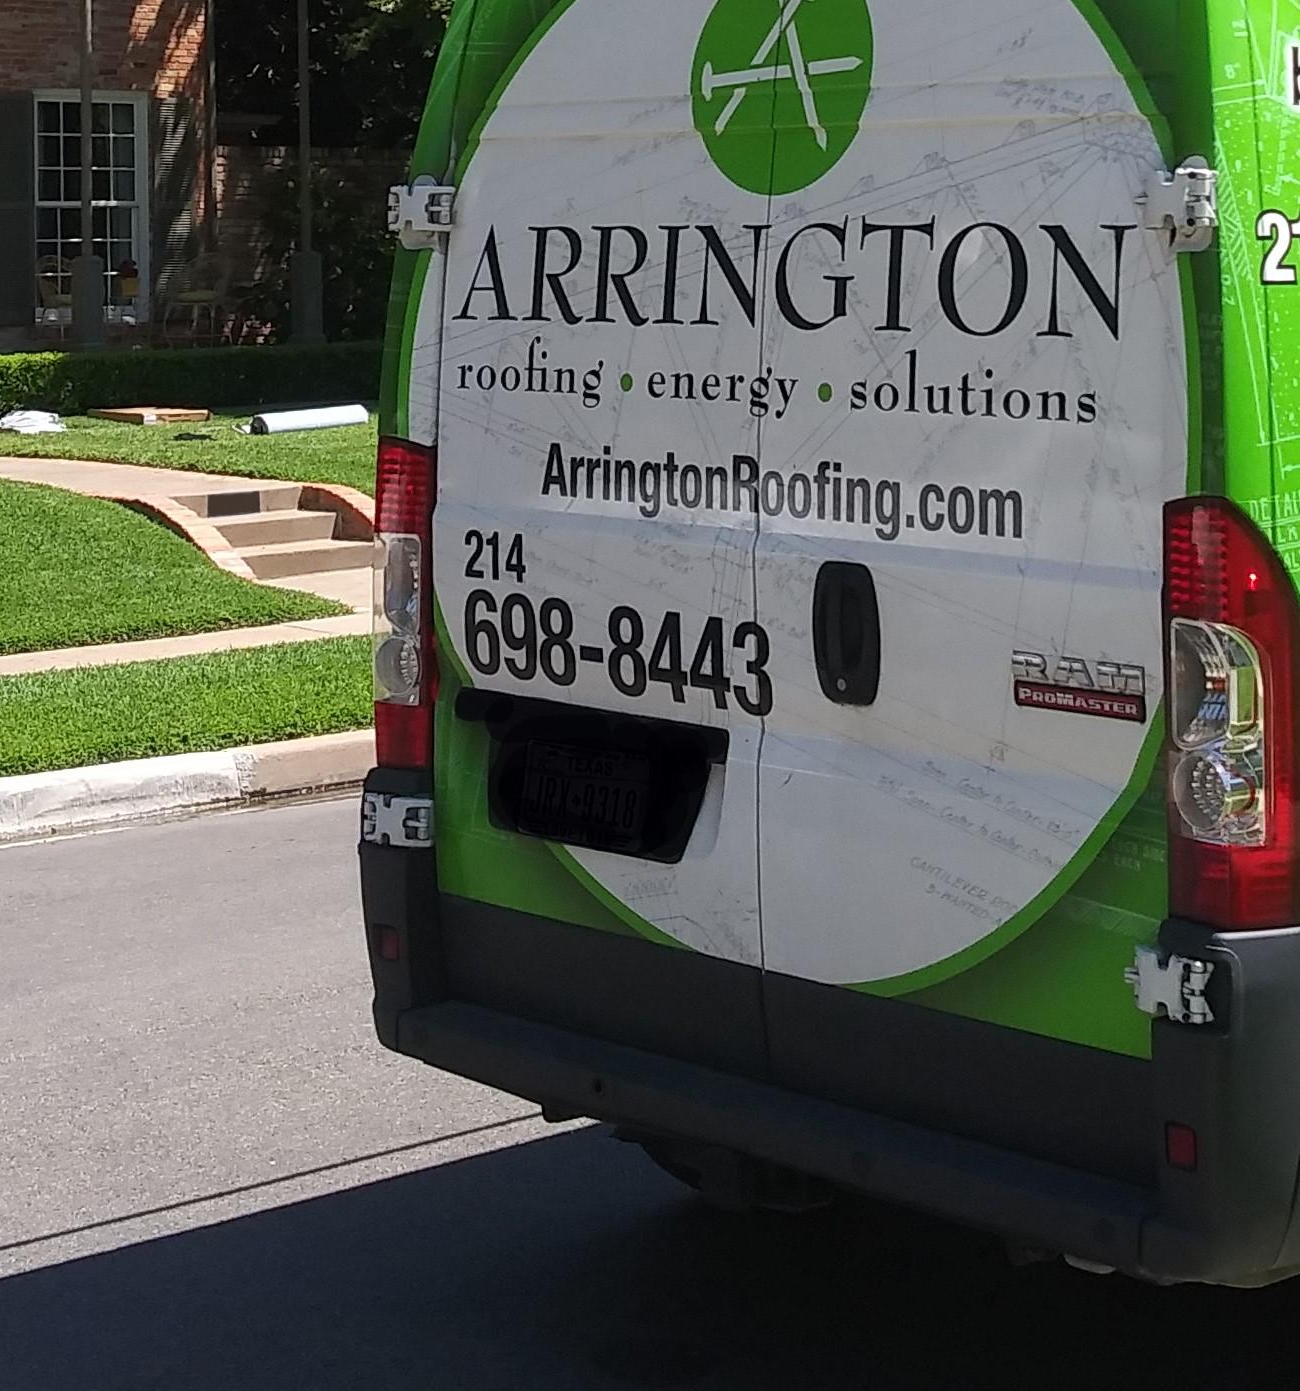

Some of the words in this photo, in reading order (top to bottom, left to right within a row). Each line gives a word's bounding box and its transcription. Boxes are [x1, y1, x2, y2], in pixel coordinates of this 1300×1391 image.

[453, 214, 1136, 340] ARRINGTON
[456, 337, 603, 407] roofing
[646, 369, 798, 419] energy
[849, 351, 1098, 424] solutions
[541, 443, 1023, 540] ArringtonRoofing.com
[463, 530, 525, 583] 214
[462, 588, 773, 717] 698-8443
[1012, 649, 1146, 696] RAM
